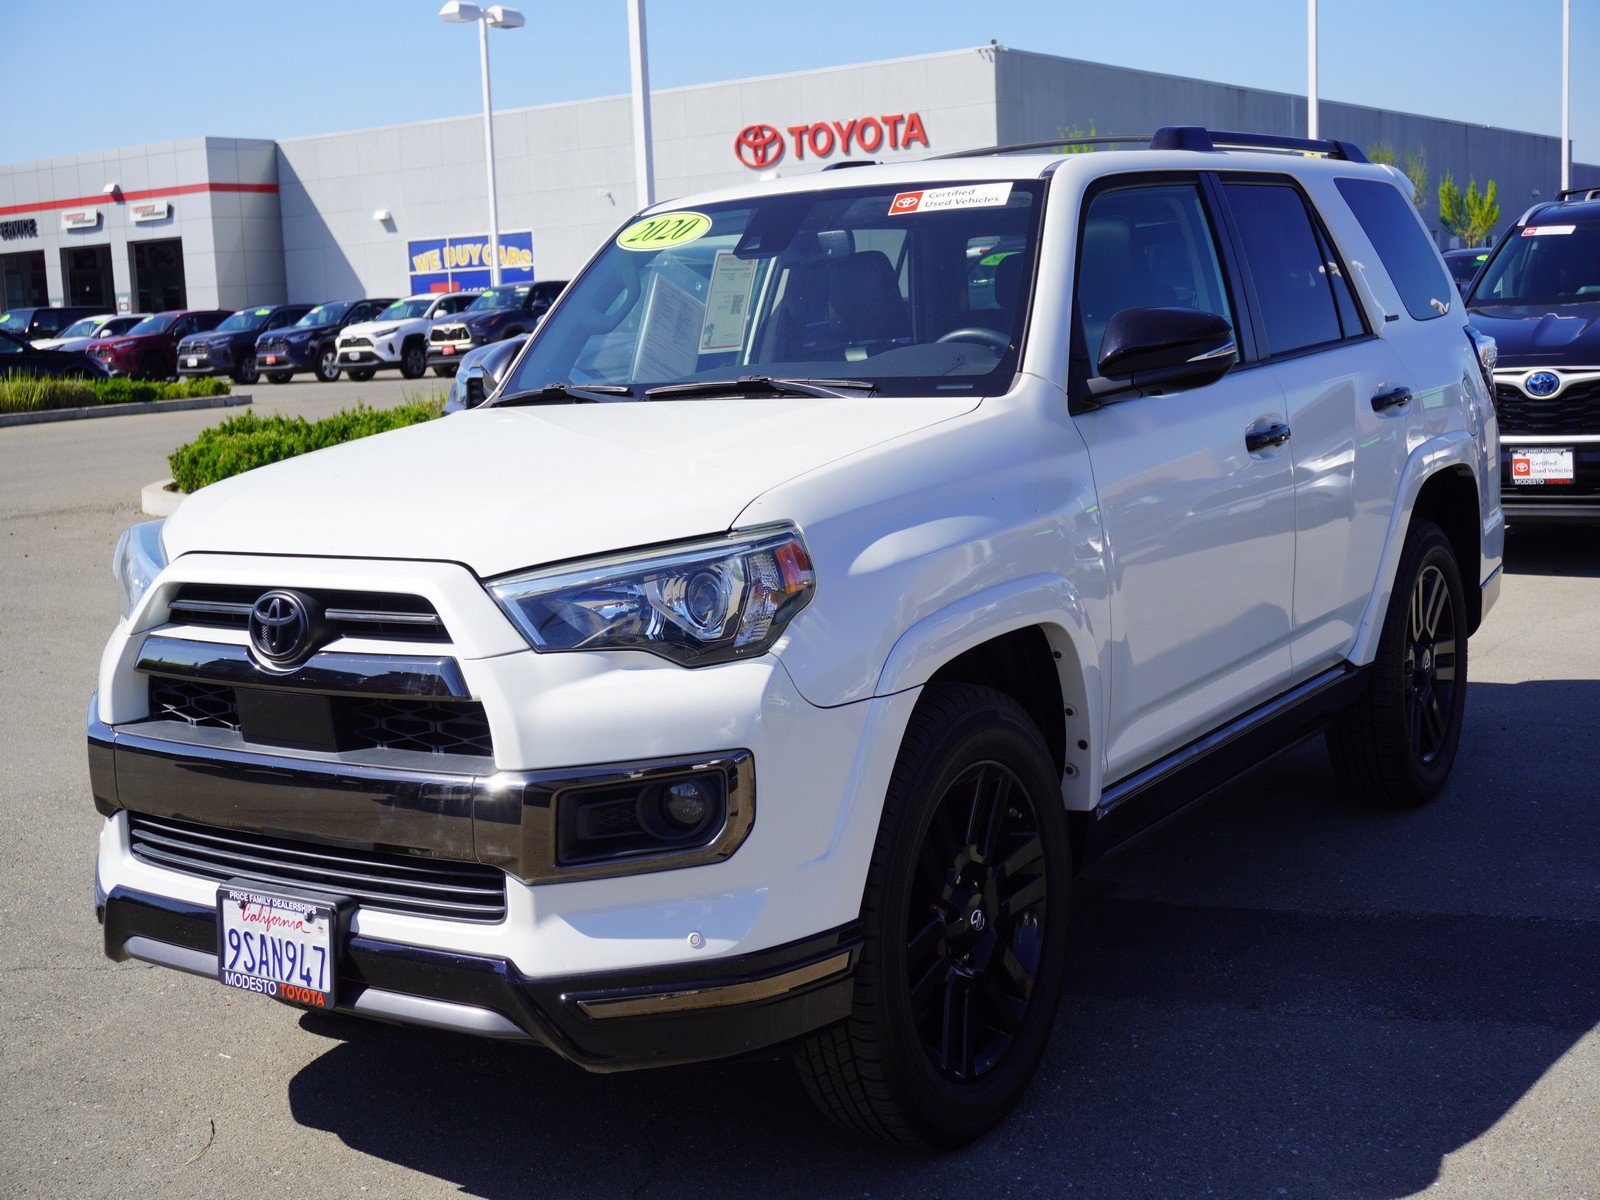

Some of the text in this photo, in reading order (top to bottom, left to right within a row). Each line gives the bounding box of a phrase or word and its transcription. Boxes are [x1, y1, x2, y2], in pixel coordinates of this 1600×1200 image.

[787, 112, 929, 157] TOYOTA
[925, 196, 1000, 208] Used Vehicles
[929, 188, 976, 199] Certified
[625, 218, 701, 243] 2020
[412, 243, 532, 273] WE BUY CARS
[229, 891, 317, 915] PRICE FAMILY DEALERSHIPS
[241, 901, 311, 934] California
[228, 928, 326, 990] 9SAN947
[225, 971, 325, 1007] MODESTO TOYOTA
